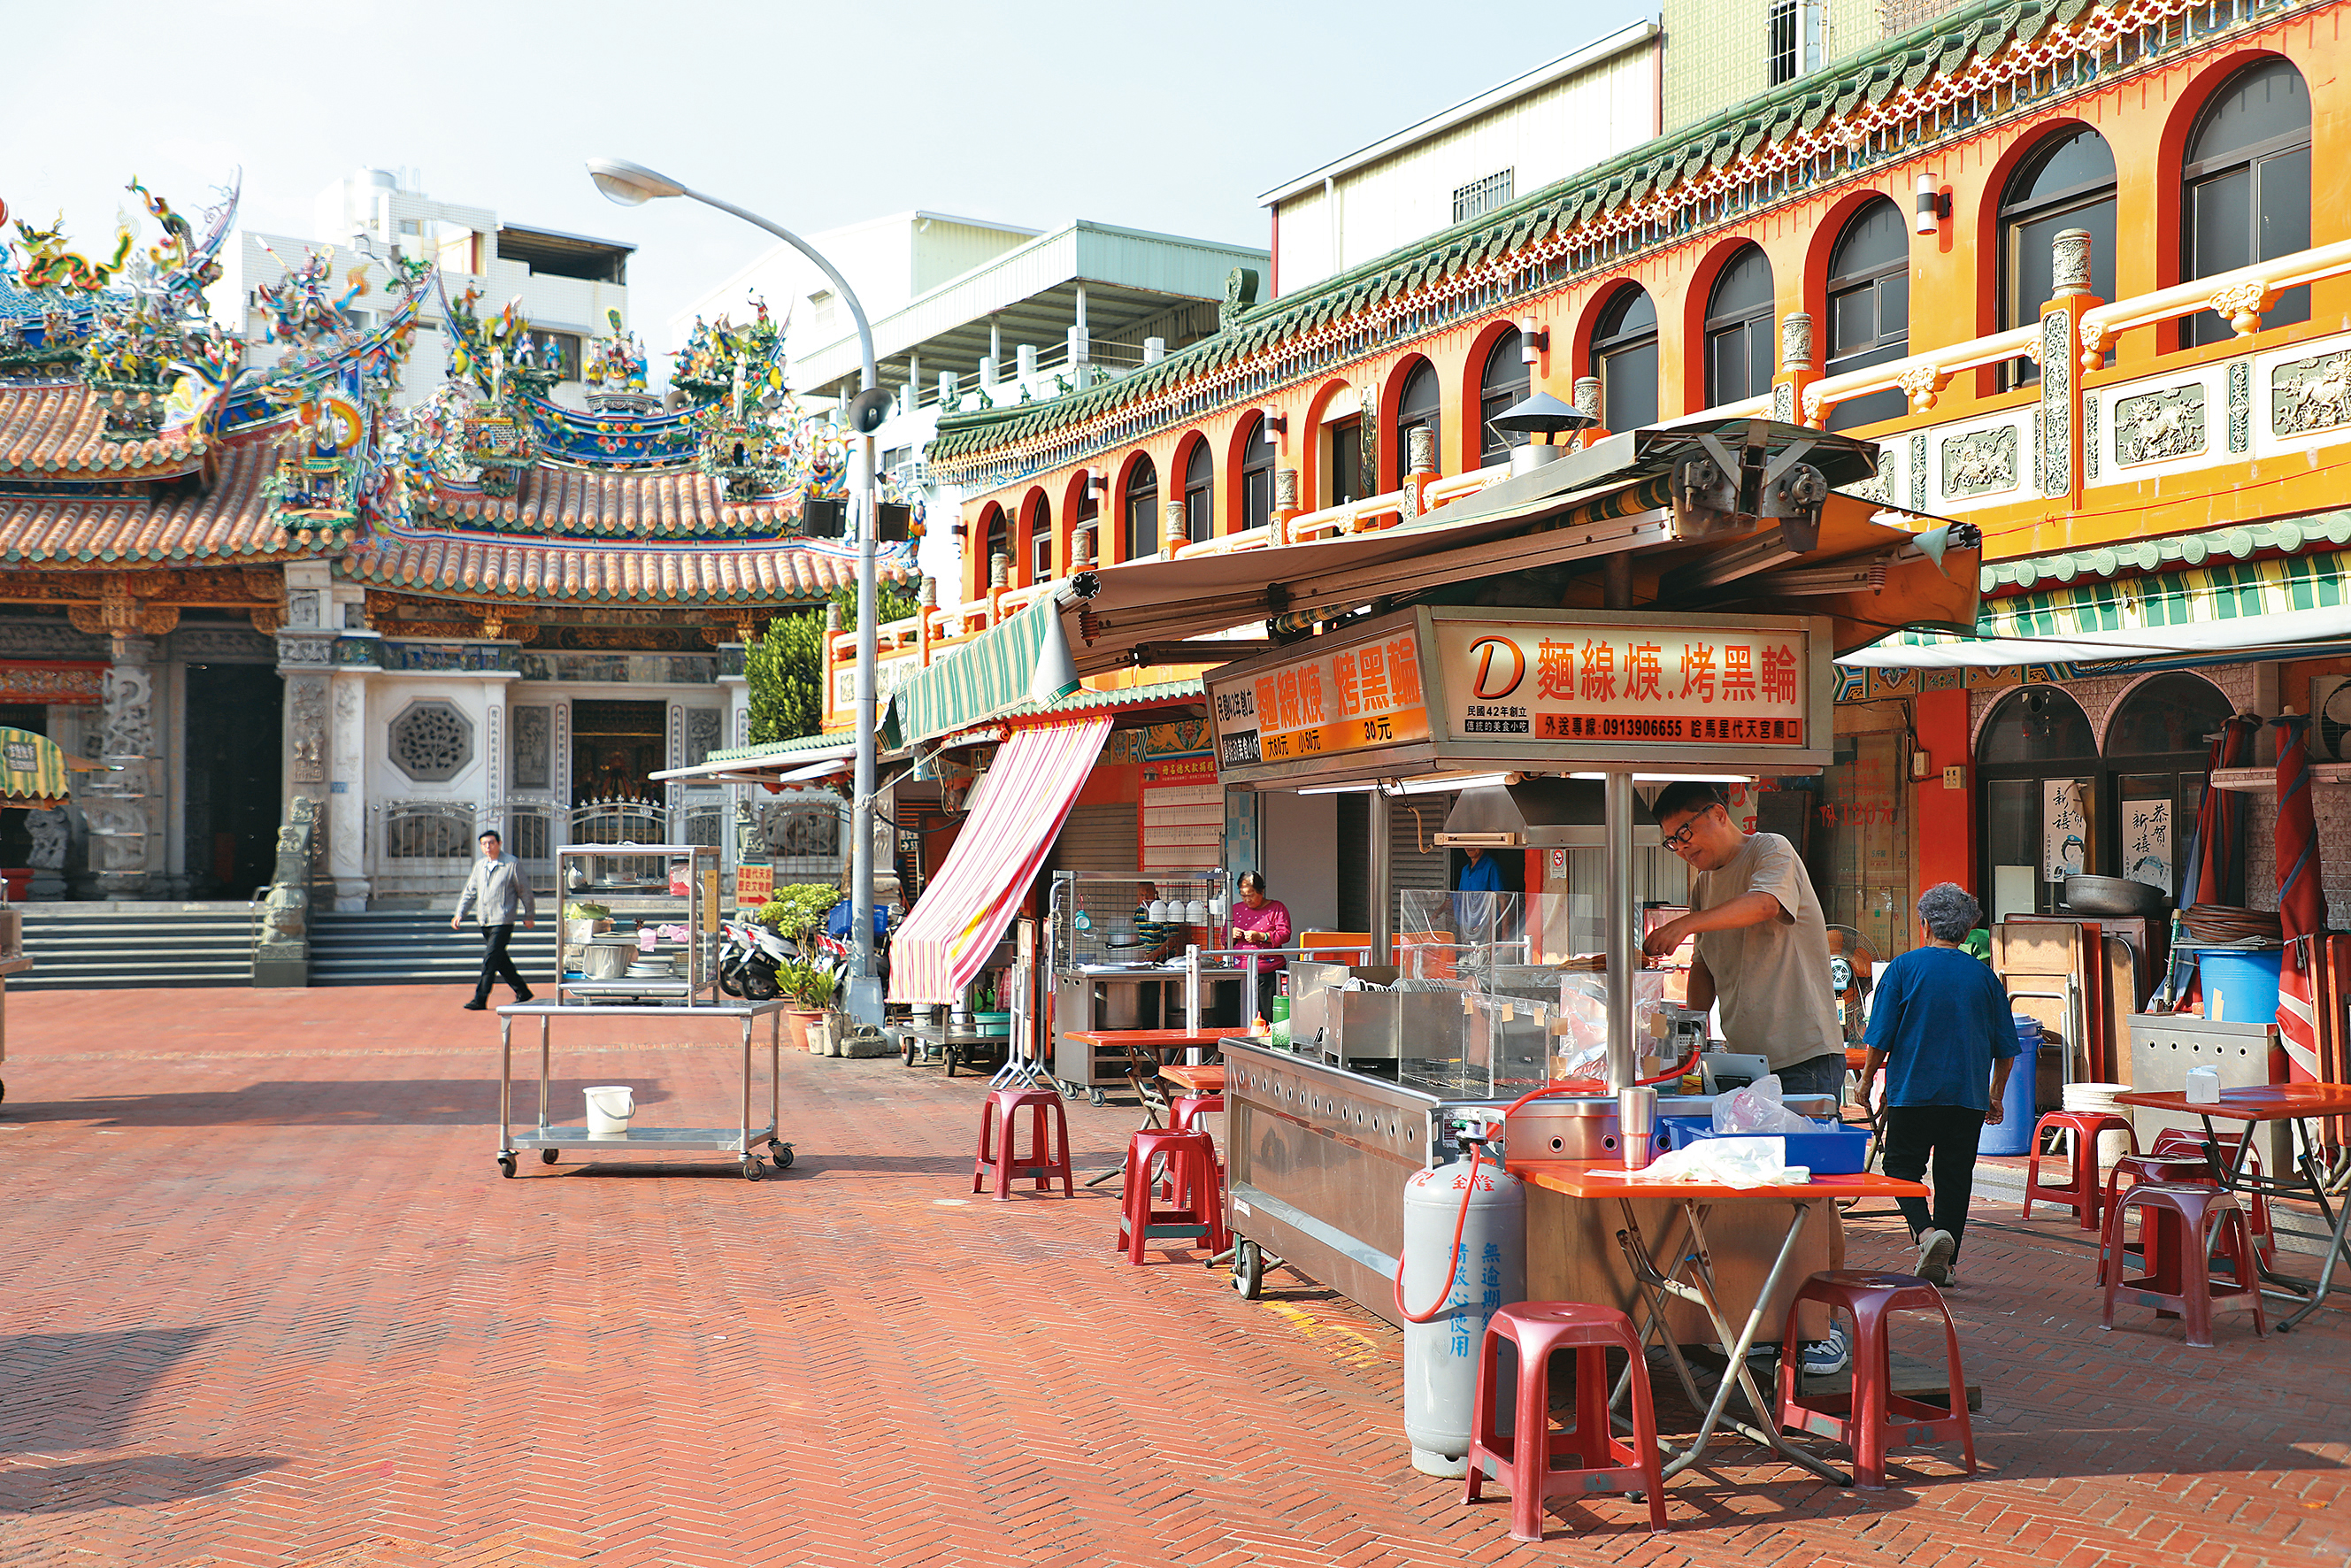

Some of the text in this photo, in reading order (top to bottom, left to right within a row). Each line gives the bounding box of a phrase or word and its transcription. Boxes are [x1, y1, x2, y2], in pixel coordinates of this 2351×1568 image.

[1333, 637, 1421, 717] 烤黑輪
[1469, 634, 1527, 700] D
[1466, 720, 1528, 733] 傳統的美食小吃
[1467, 705, 1527, 718] 民國42年創立
[1267, 716, 1393, 758] 大60元 小50元 30元
[1691, 719, 1799, 740] 哈馬星代天宮廟口
